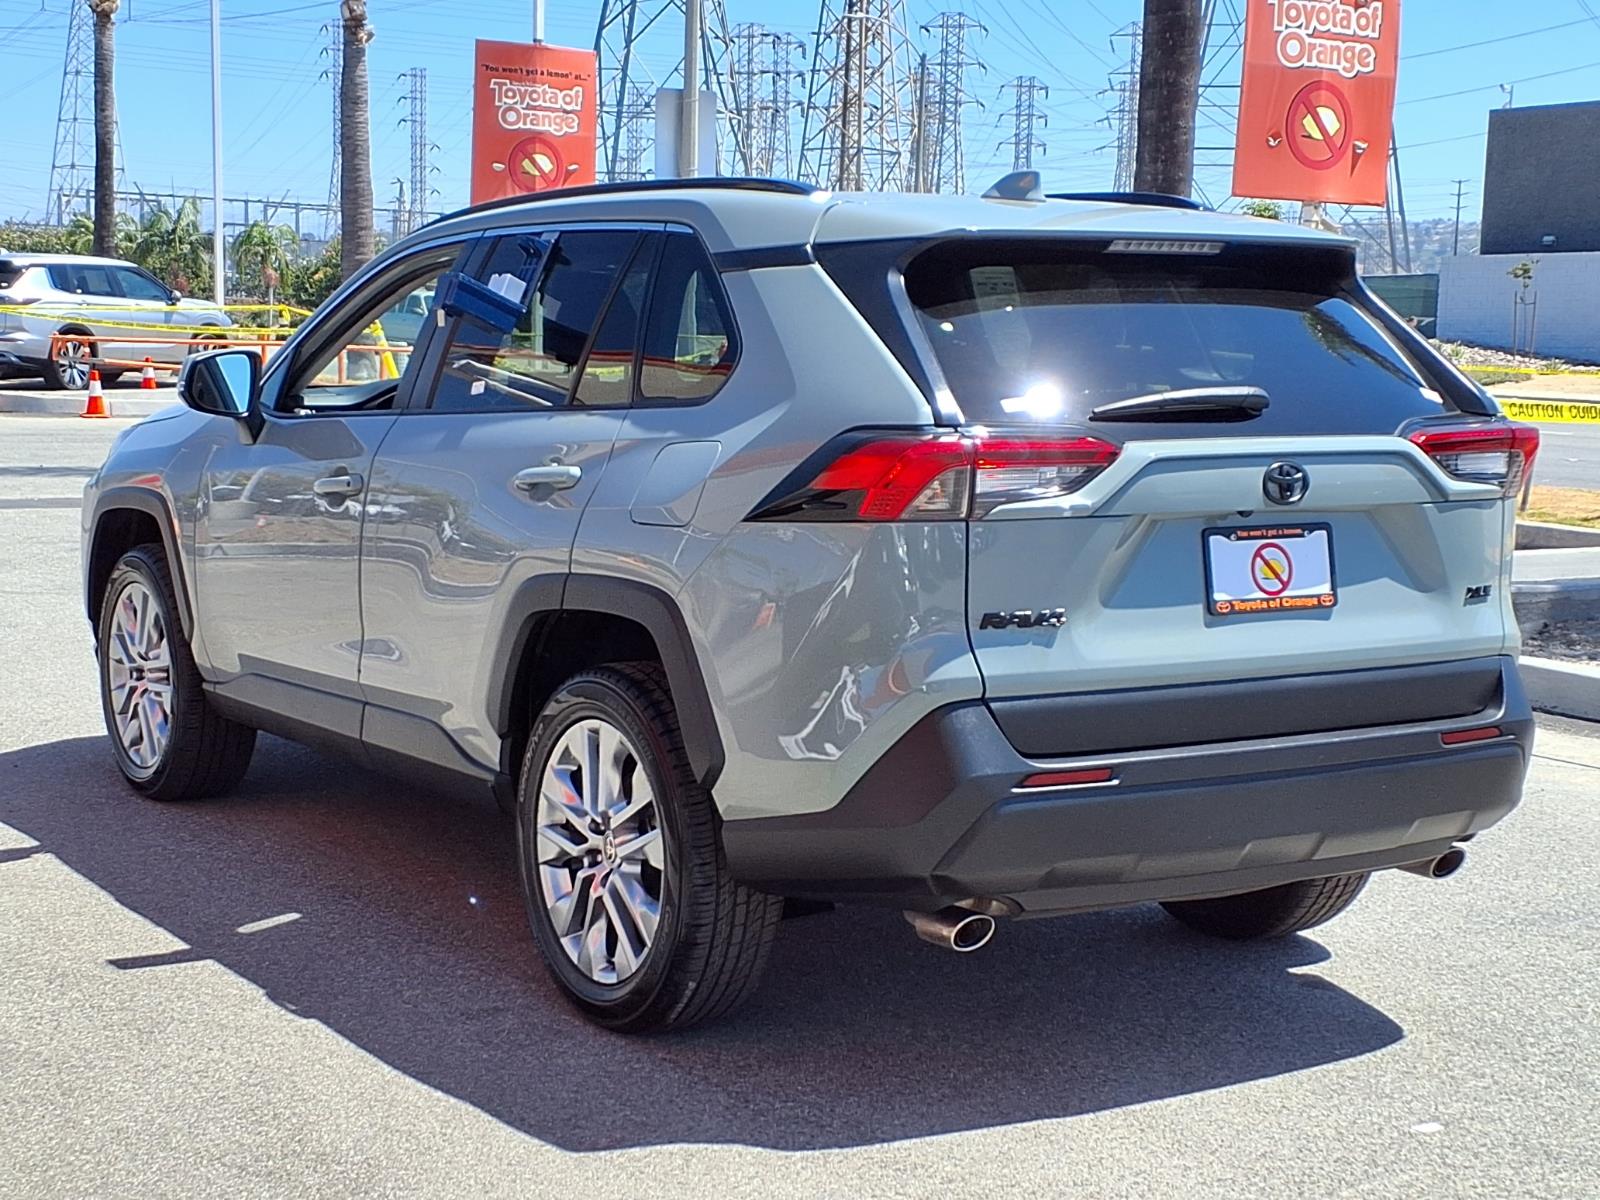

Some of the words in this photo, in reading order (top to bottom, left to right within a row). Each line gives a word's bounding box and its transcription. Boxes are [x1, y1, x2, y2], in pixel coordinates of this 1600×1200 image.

[1268, 0, 1354, 34] Toyota
[1354, 2, 1382, 38] of
[1277, 28, 1375, 77] Orange
[501, 66, 523, 74] won't
[490, 79, 558, 108] Toyota
[558, 86, 583, 110] of
[498, 104, 578, 135] Orange
[1509, 402, 1563, 418] CAUTION
[1568, 405, 1600, 419] CUID
[979, 608, 1066, 630] RAV4
